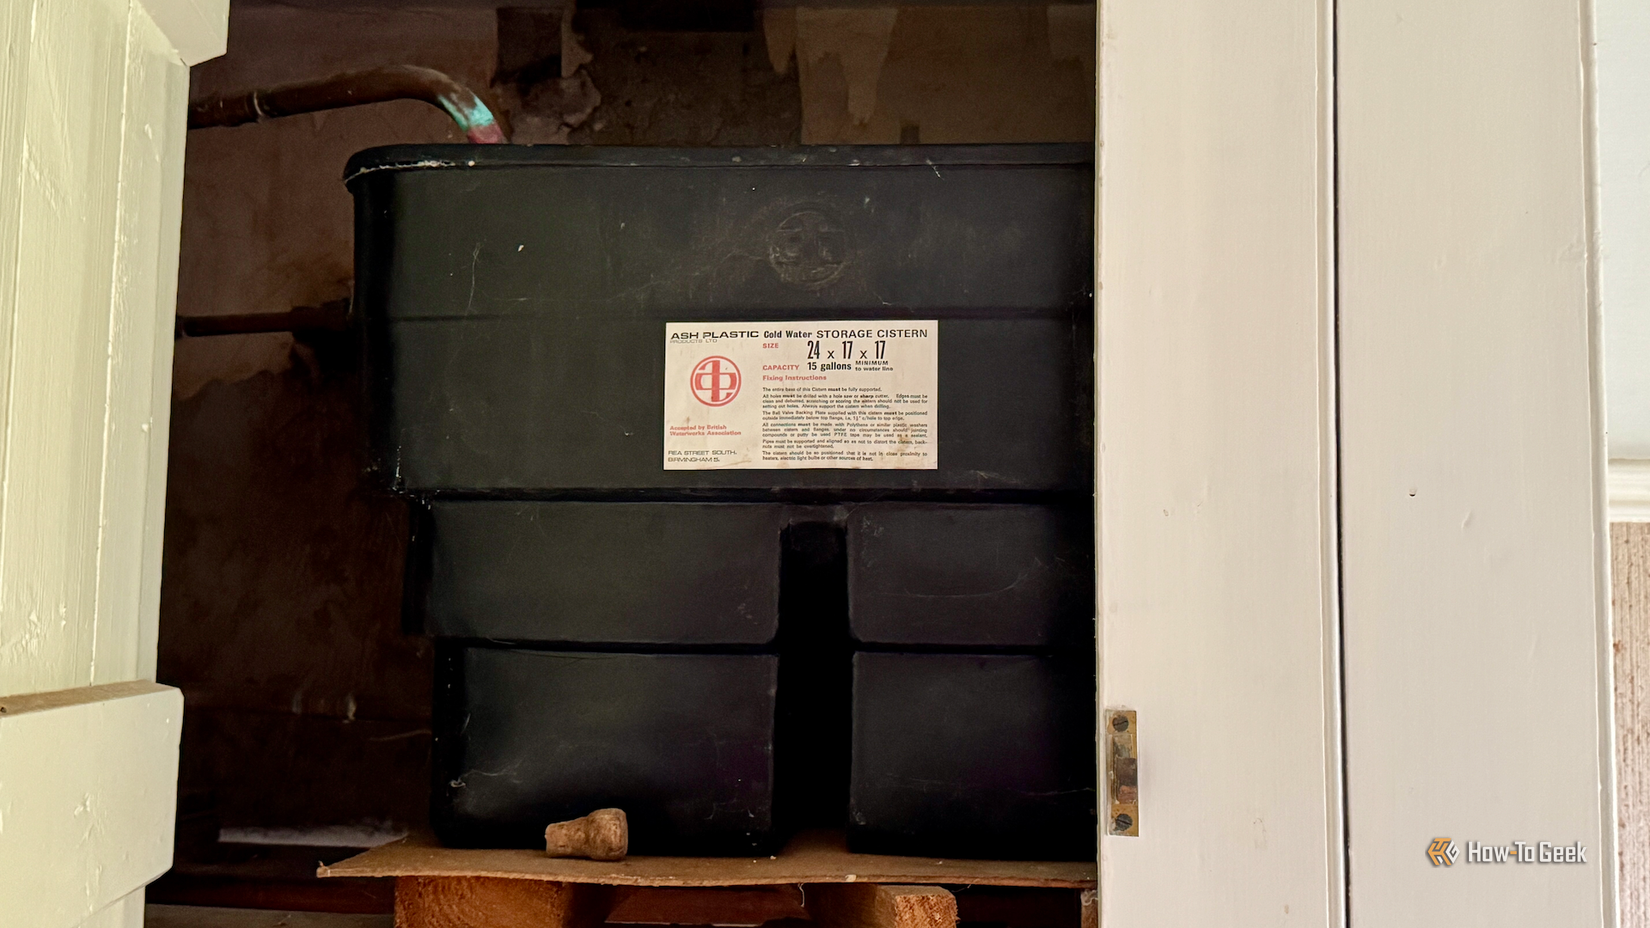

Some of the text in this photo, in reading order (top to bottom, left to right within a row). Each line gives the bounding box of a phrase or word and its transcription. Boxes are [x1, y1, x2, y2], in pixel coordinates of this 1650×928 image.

[816, 330, 873, 338] STORAGE
[877, 329, 928, 338] CISTERN
[807, 340, 820, 359] 24
[842, 341, 853, 359] 17
[875, 341, 886, 359] 17
[807, 362, 817, 370] 15
[821, 362, 851, 372] gallons
